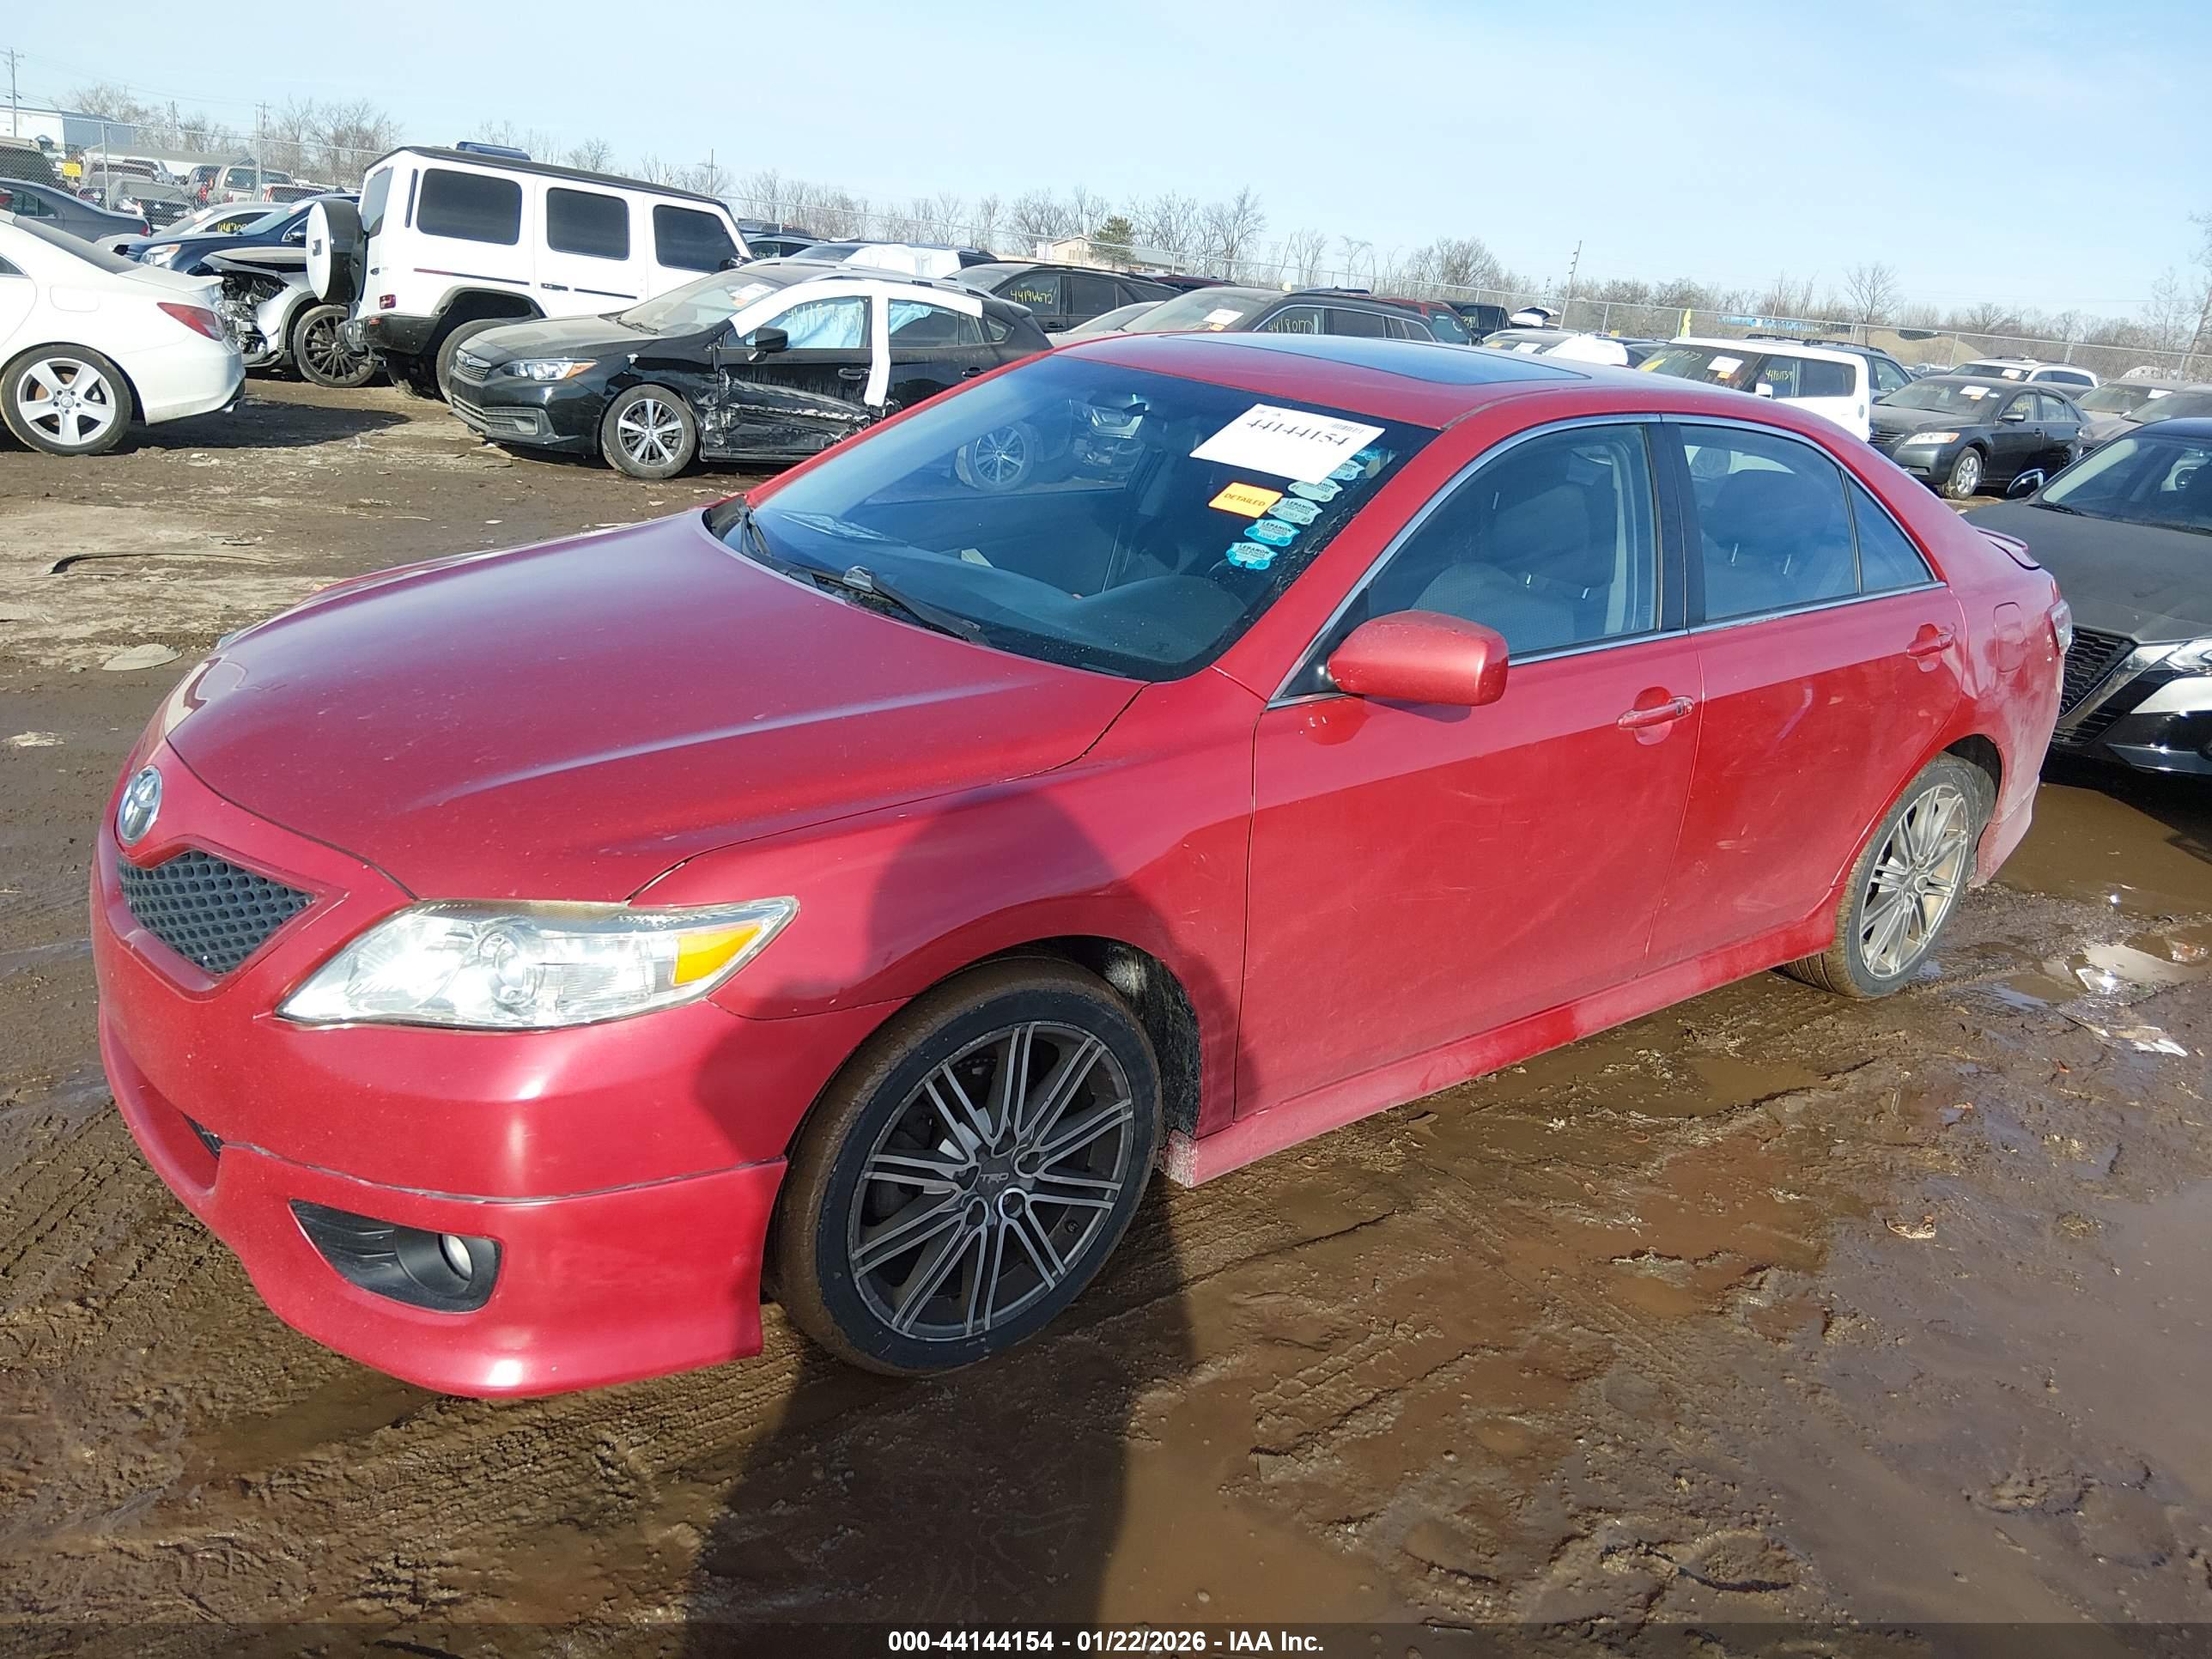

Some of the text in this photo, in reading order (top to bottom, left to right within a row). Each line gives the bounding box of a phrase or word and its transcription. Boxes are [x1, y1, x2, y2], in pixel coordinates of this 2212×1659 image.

[1246, 419, 1350, 447] 44144154
[1223, 492, 1267, 507] DETAILED
[1287, 500, 1316, 512] LEBANON
[1262, 522, 1292, 532] LEBANON
[1239, 544, 1270, 555] LEBANON
[980, 1172, 1010, 1184] TRD
